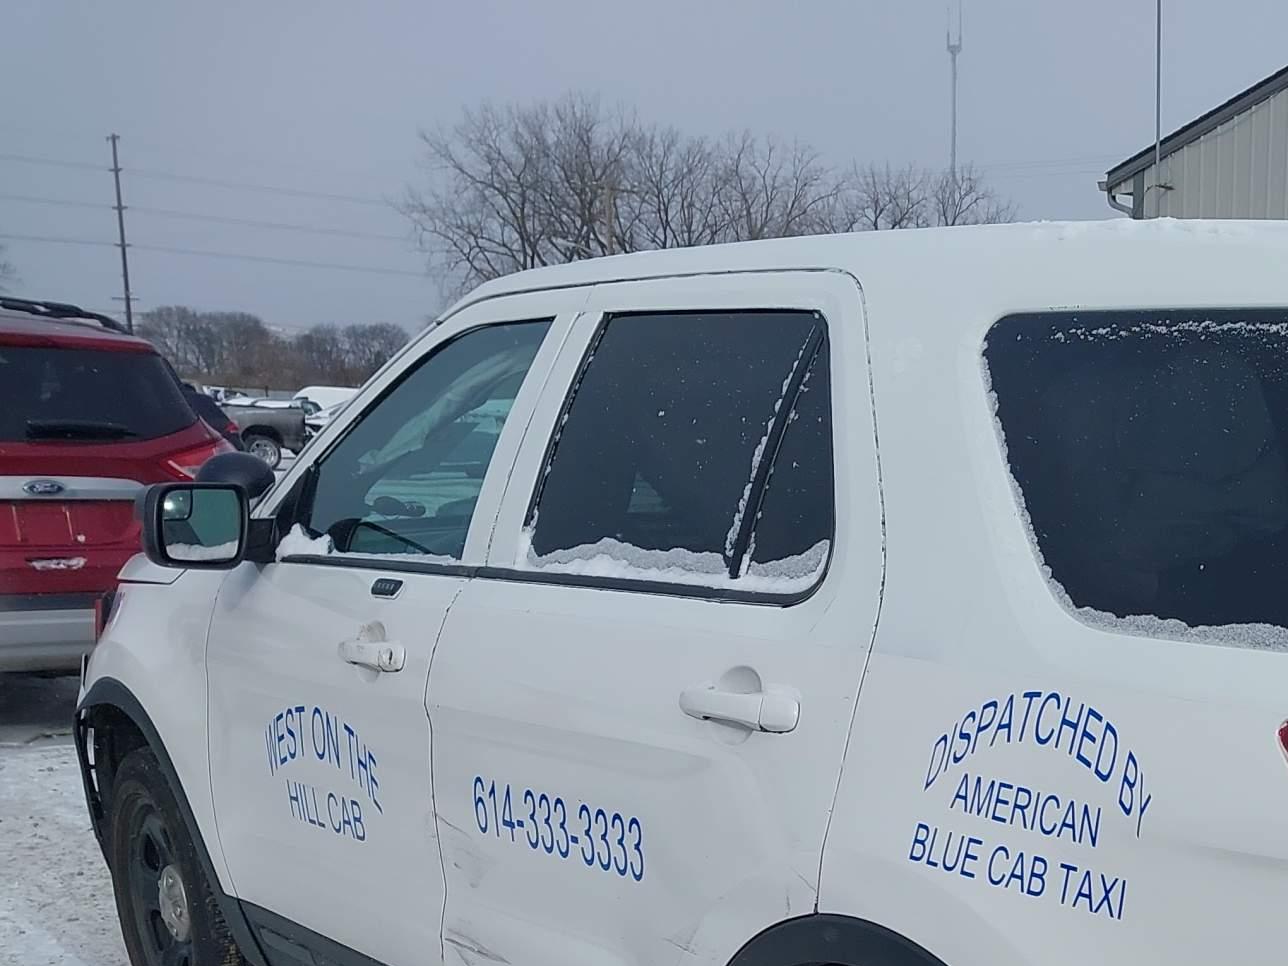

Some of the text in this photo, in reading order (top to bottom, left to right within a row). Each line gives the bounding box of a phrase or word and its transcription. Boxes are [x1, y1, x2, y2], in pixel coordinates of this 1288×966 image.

[264, 705, 384, 815] WEST ON THE
[286, 778, 366, 842] HILL CAB
[923, 691, 1152, 839] DISPATCHED BY
[949, 772, 1102, 848] AMERICAN
[473, 775, 645, 882] 614-333-3333
[908, 822, 1127, 921] BLUE CAB TAXI
